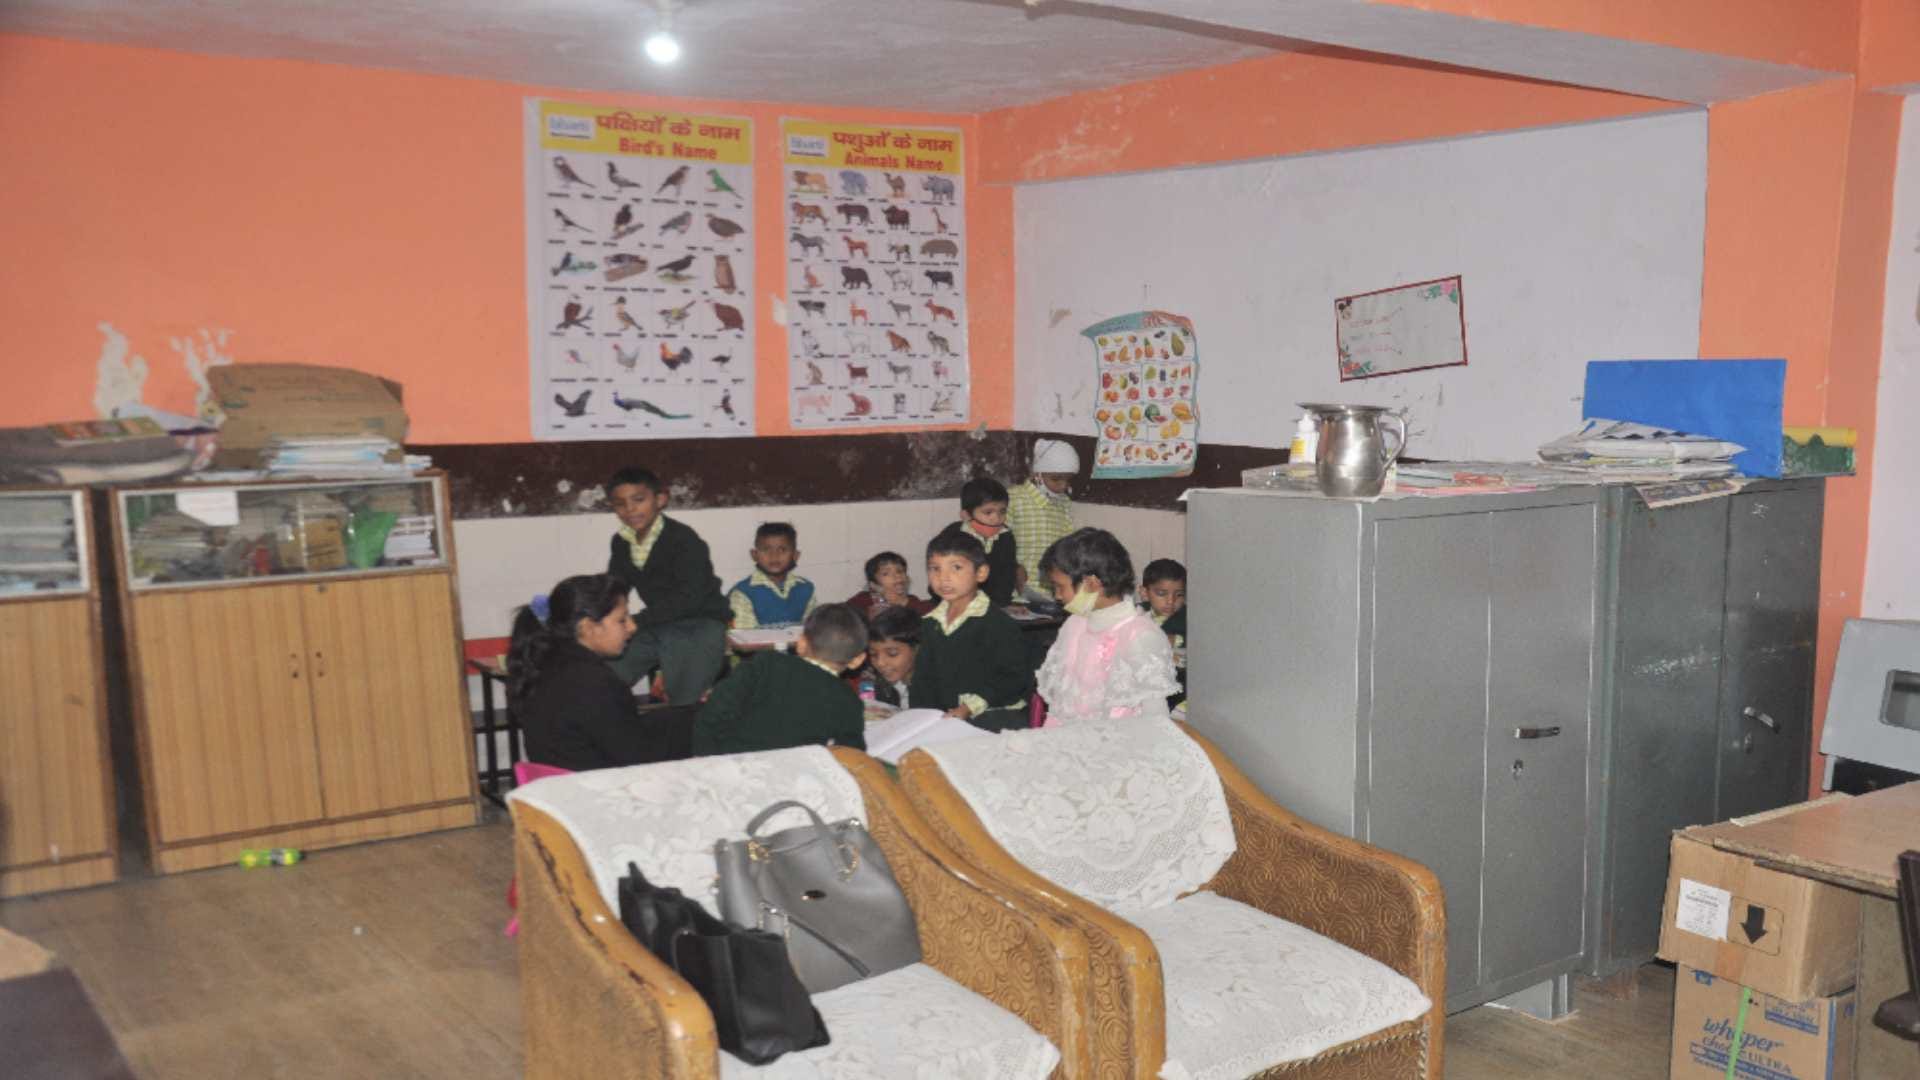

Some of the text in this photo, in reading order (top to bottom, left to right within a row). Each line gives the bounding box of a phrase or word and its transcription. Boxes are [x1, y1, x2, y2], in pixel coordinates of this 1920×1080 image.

[597, 111, 667, 134] पक्षियों
[699, 124, 741, 140] नाम
[619, 137, 717, 160] Bird's Name
[832, 131, 891, 152] पशुओं
[917, 138, 953, 152] नाम
[845, 152, 944, 170] Animals Name
